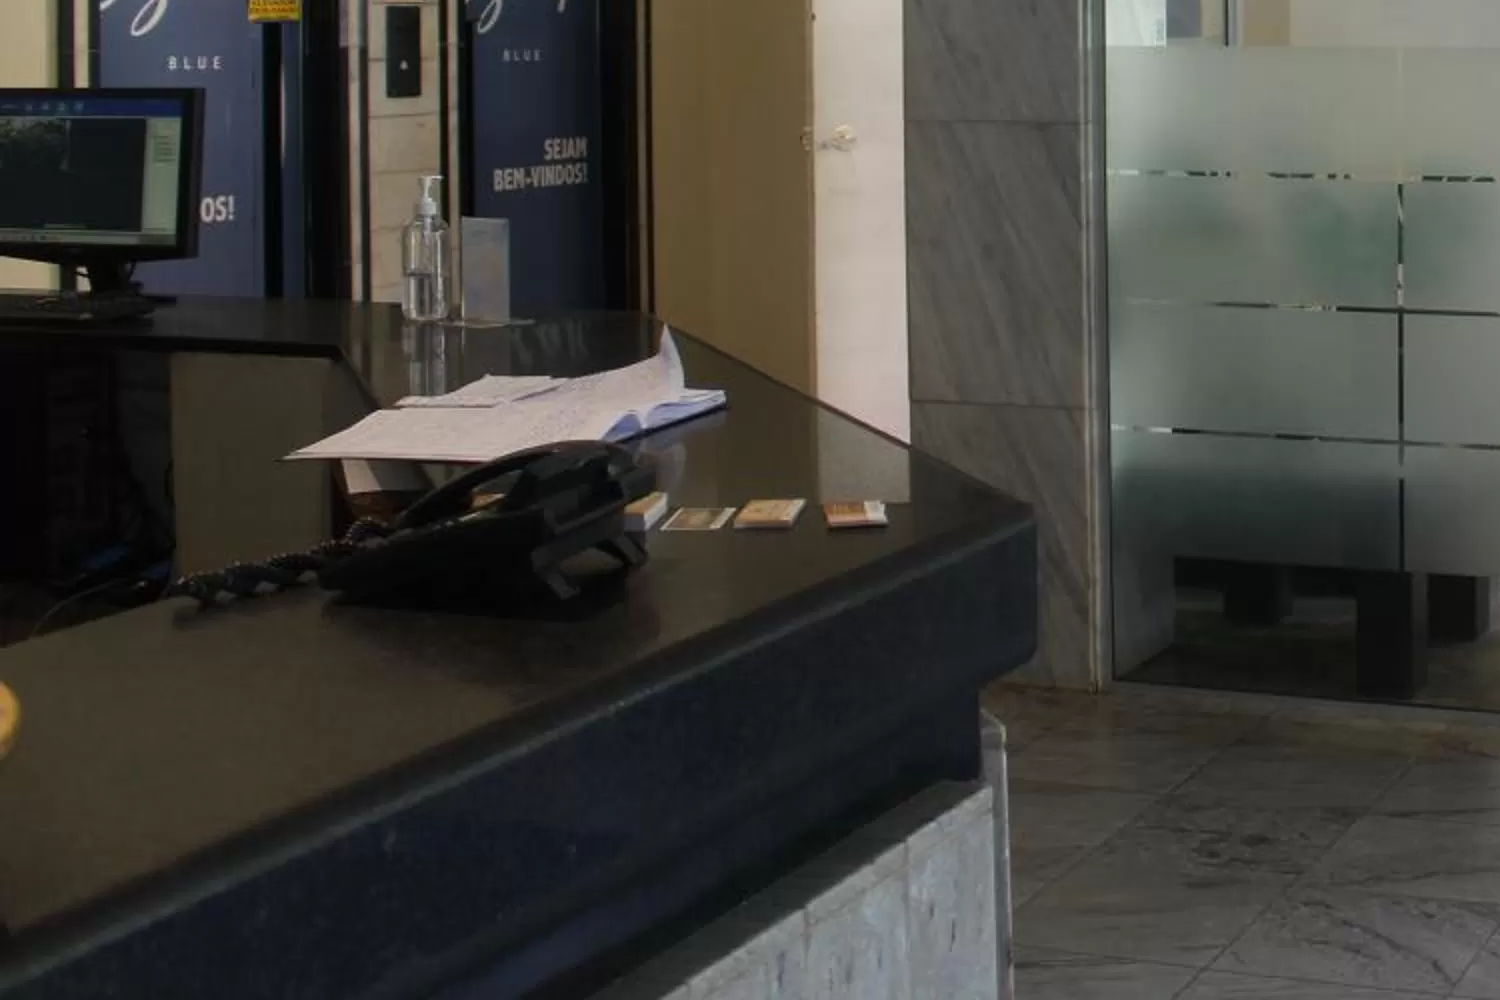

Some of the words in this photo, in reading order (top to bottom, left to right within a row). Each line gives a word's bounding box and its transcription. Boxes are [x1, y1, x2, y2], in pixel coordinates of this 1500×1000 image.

[168, 55, 224, 70] BLUE
[502, 49, 543, 62] BLUE
[543, 137, 588, 161] SEJAM
[493, 163, 588, 192] BEM-VINDOS!
